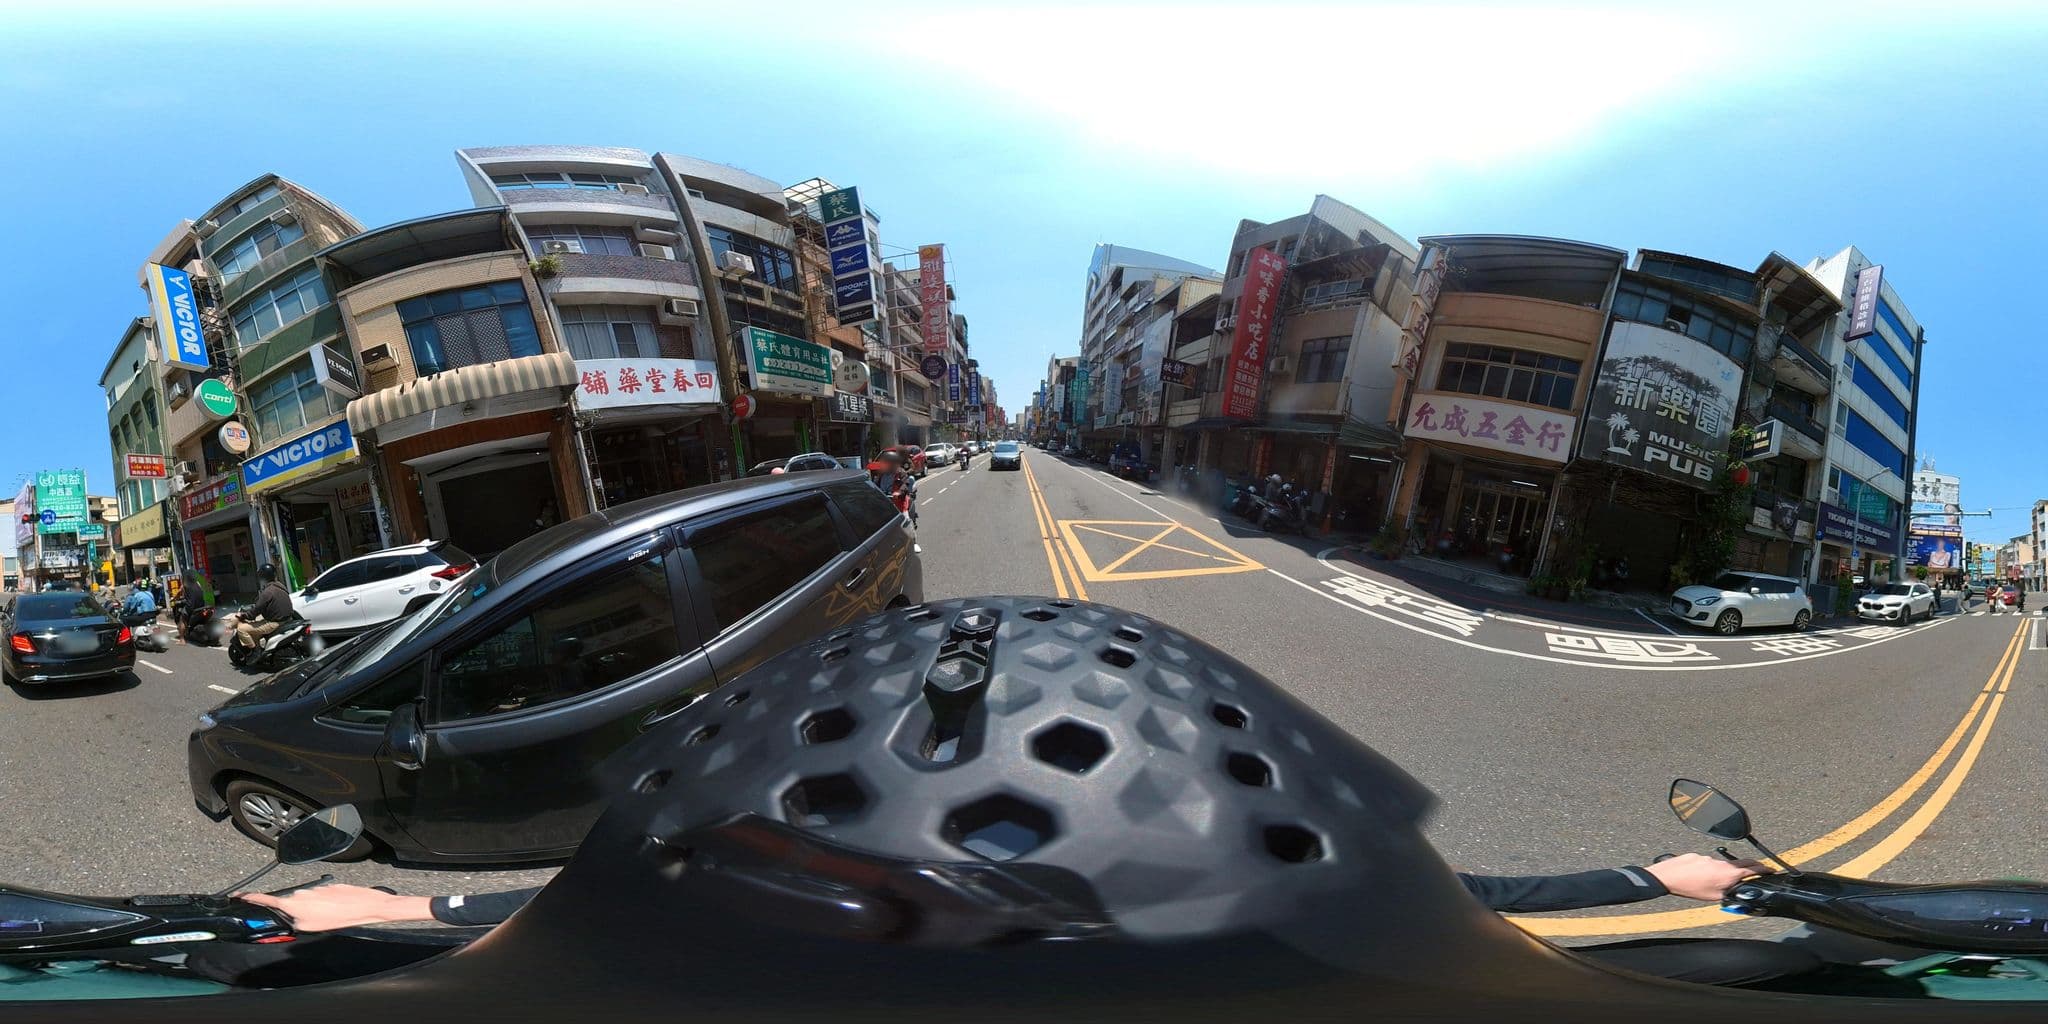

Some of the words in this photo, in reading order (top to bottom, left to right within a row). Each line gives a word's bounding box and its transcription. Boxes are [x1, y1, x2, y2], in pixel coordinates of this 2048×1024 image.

[829, 192, 853, 218] 蔡氏
[836, 279, 870, 293] BROOKS
[171, 295, 202, 358] VICTOR
[755, 337, 829, 366] 蔡氏體育用品社
[204, 391, 232, 405] conti
[1614, 371, 1722, 439] 新樂園
[1411, 402, 1566, 454] 允成五金行
[269, 428, 344, 468] VICTOR
[1643, 445, 1714, 482] PUB
[1648, 430, 1716, 463] MUSIC
